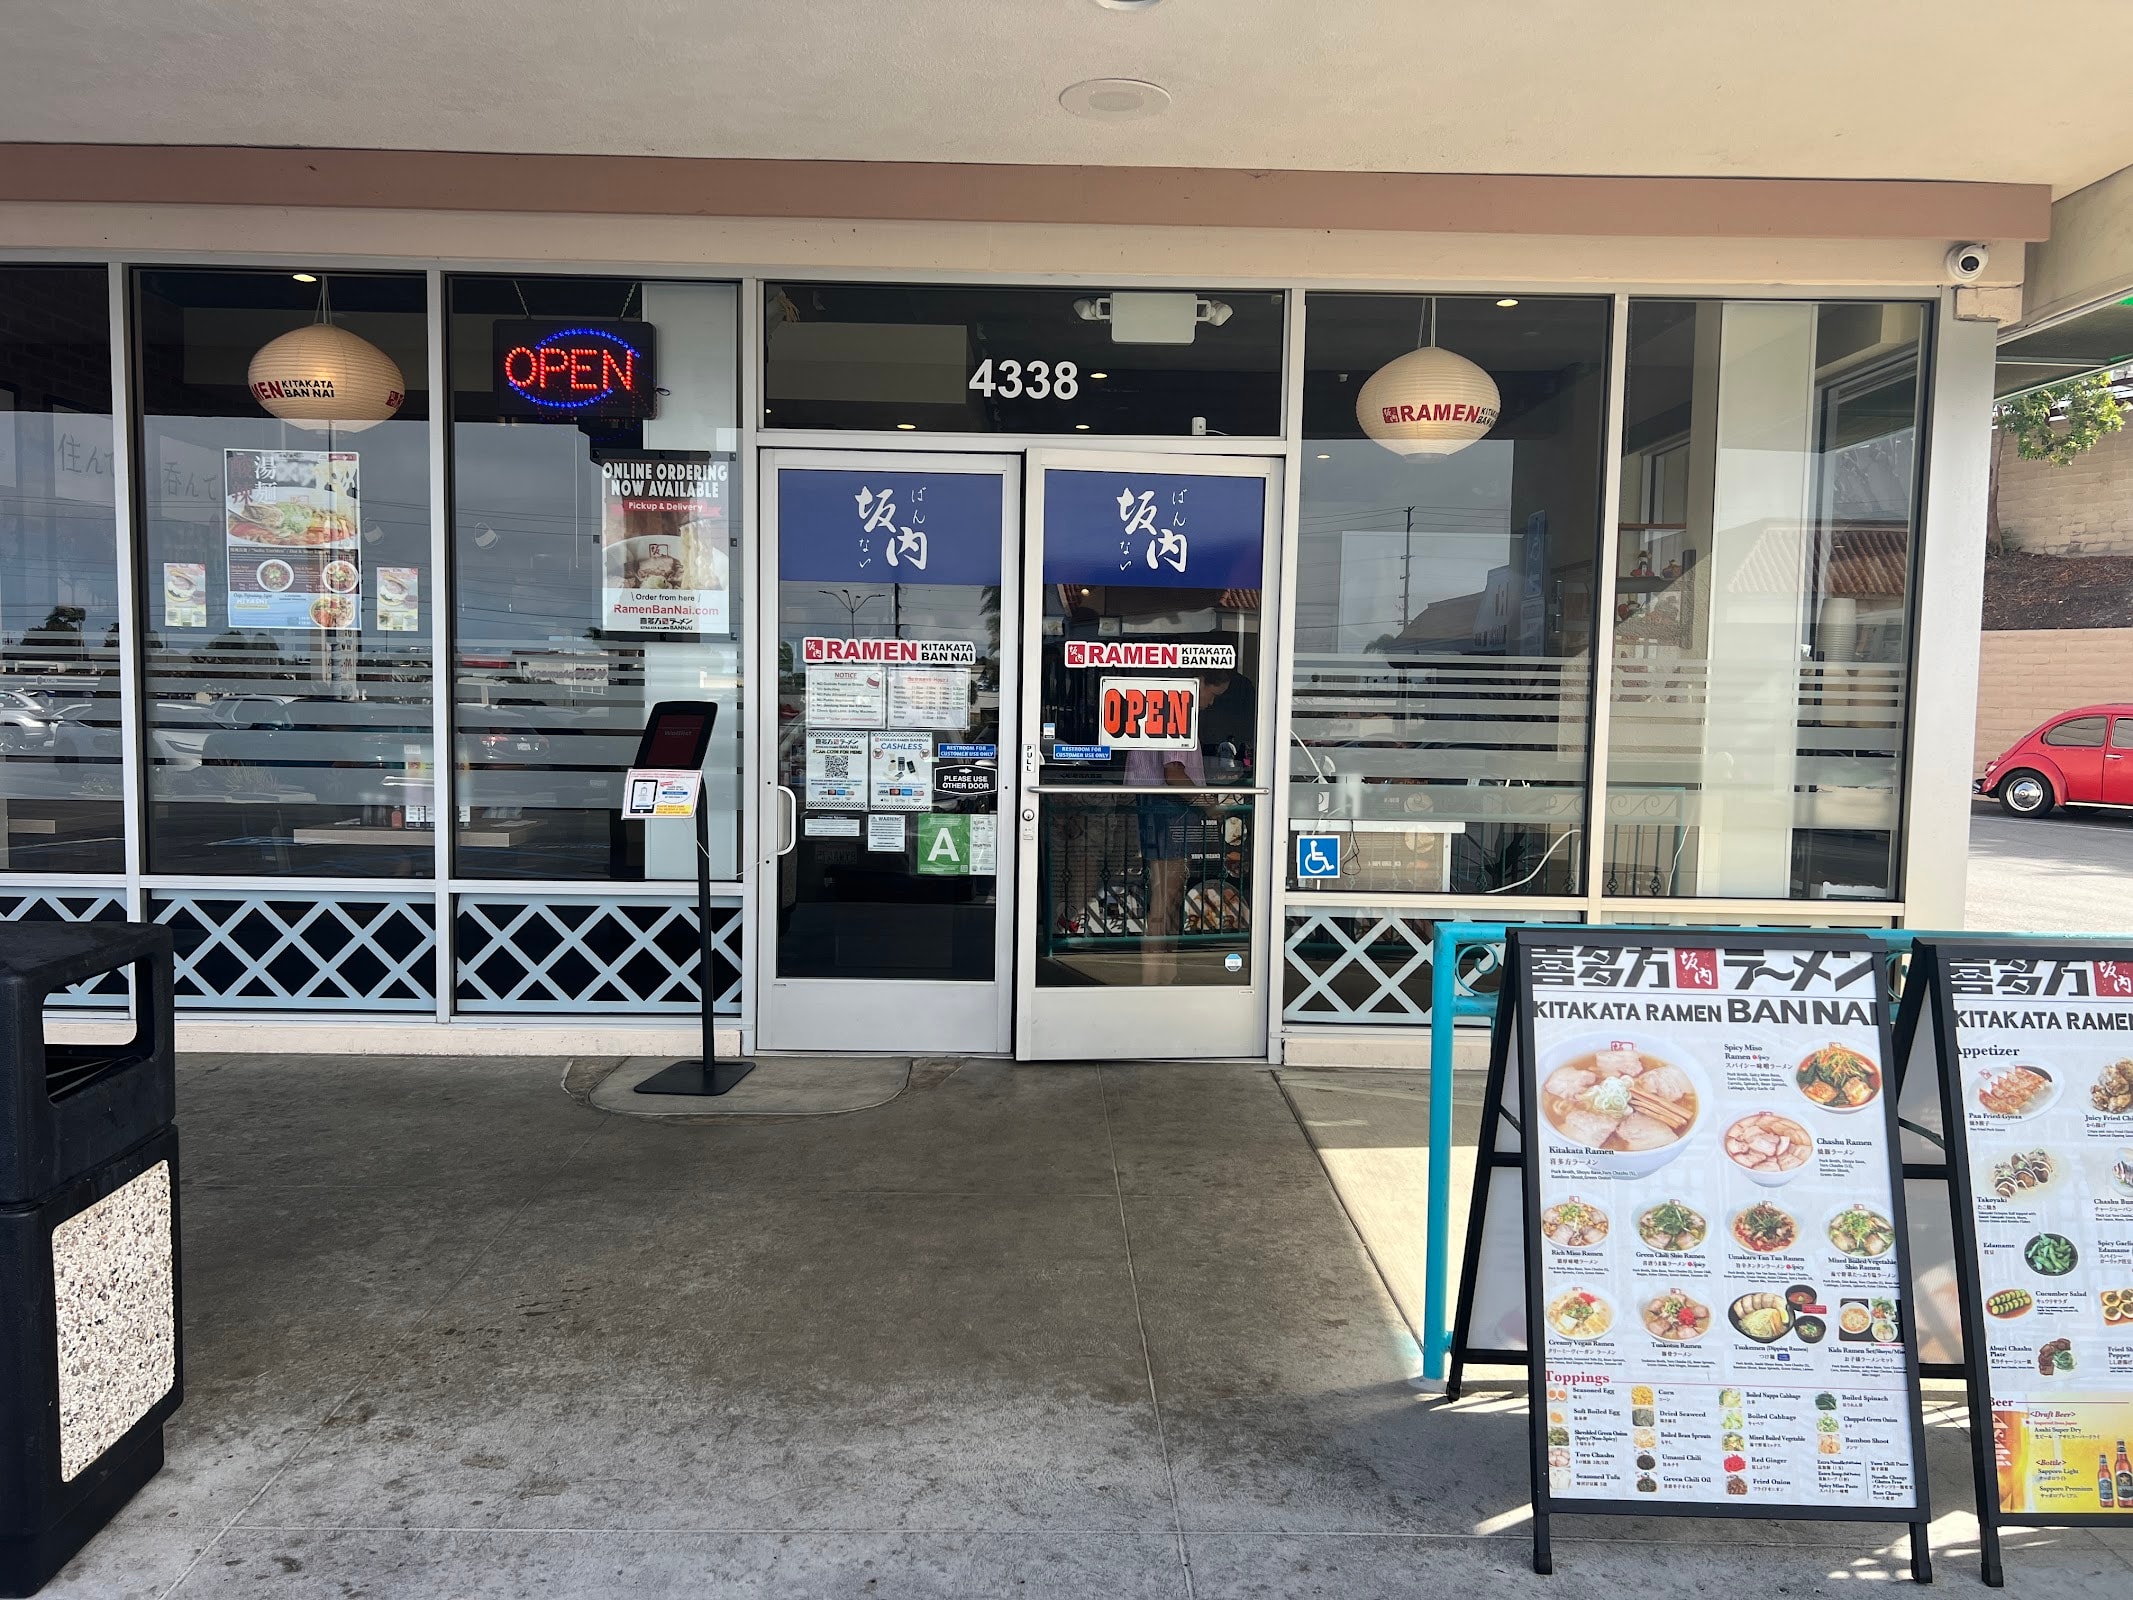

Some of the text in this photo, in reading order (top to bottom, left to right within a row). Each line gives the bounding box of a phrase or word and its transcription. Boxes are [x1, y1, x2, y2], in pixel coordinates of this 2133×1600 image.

[505, 346, 632, 390] OPEN
[282, 380, 334, 388] KITAKATA
[969, 359, 1078, 400] 4338
[285, 389, 334, 398] BAN NAI
[1400, 404, 1480, 423] RAMEN
[603, 462, 727, 481] ONLINE ORDERING
[611, 480, 719, 497] NOW AVAILABLE
[629, 502, 658, 511] Pickup
[666, 503, 703, 512] Delivery
[912, 487, 926, 524] ばん
[1172, 489, 1187, 526] ばん
[855, 486, 927, 570] 坂内
[1117, 488, 1187, 572] 坂内
[614, 605, 719, 615] RamenBanNai.com
[827, 642, 917, 660] RAMEN
[922, 653, 973, 661] BAN NAI
[1088, 646, 1177, 665] RAMEN
[1181, 647, 1232, 655] KITAKATA
[1182, 656, 1232, 665] BAN NAI
[1104, 688, 1192, 739] OPEN
[927, 828, 960, 861] A
[1680, 951, 1713, 986] 坂内
[1723, 948, 1874, 992] ラーメン
[2098, 961, 2132, 993] 坂内
[1534, 1001, 1640, 1021] KITAKATA
[1646, 1004, 1722, 1023] RAMEN
[1955, 1010, 2059, 1030] KITAKATA
[1725, 1044, 1743, 1052] Spicy
[1958, 1045, 2020, 1058] ppetizer
[1549, 1146, 1584, 1154] Kitakata
[1817, 1138, 1844, 1146] Chashu
[1869, 1258, 1897, 1266] Vegetable
[1545, 1370, 1609, 1386] Toppings
[1990, 1397, 2013, 1406] Beer
